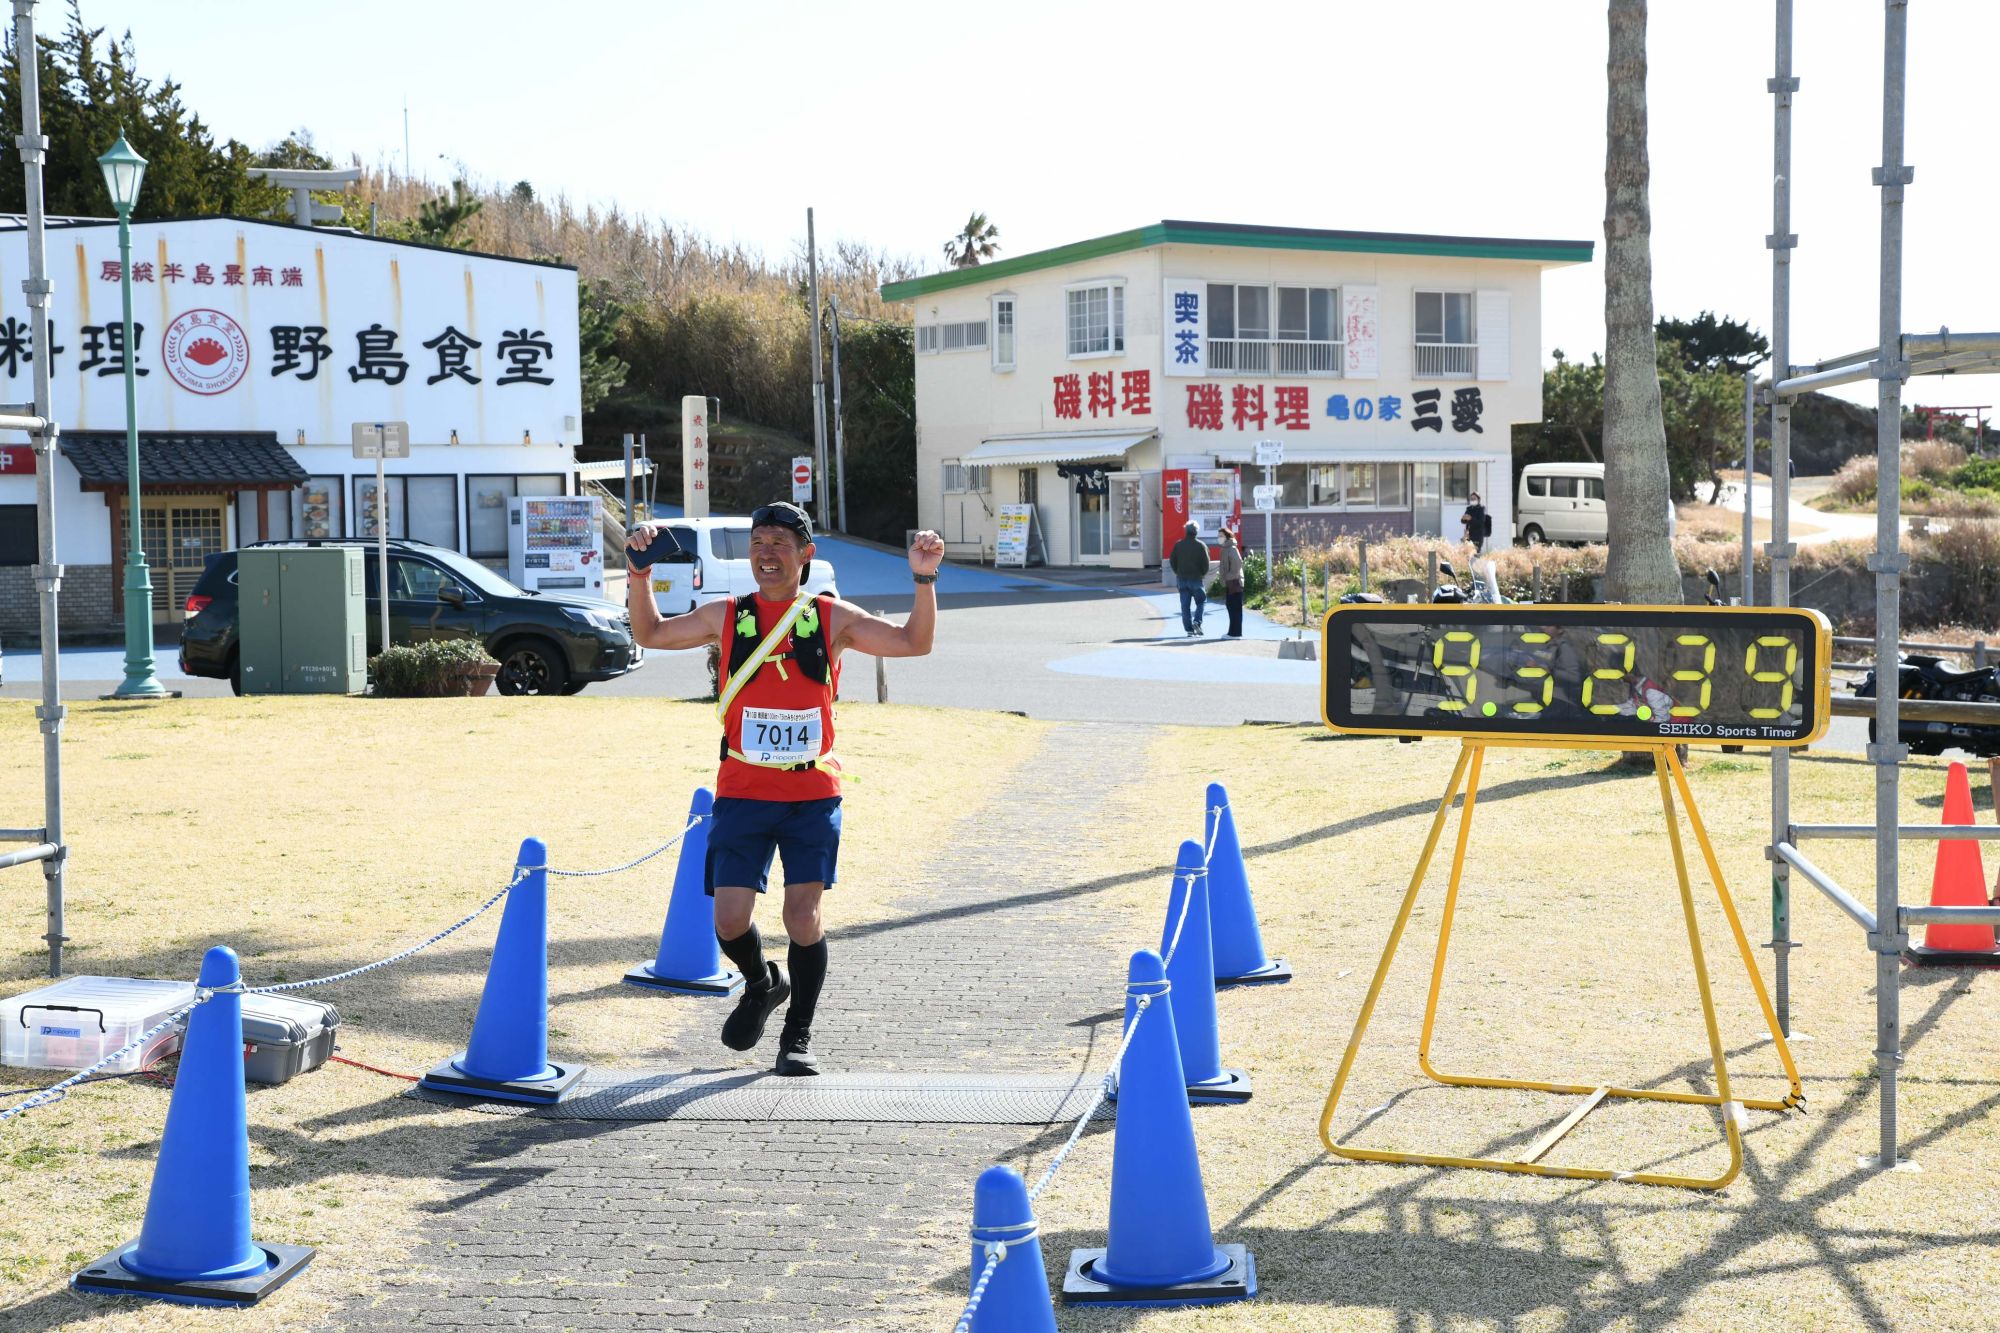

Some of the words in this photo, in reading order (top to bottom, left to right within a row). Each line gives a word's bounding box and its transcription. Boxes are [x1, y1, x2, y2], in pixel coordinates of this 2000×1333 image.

[101, 261, 304, 287] 房総半島最南端
[173, 313, 236, 335] 野島食堂
[1174, 291, 1200, 364] 喫茶
[270, 323, 555, 386] 野島食堂
[176, 366, 203, 388] NOJIMA
[205, 366, 239, 389] SHOKUDO
[1053, 369, 1151, 420] 磯料理
[1186, 383, 1311, 432] 磯料理
[1326, 394, 1402, 421] 亀の家
[1410, 386, 1485, 434] 三愛
[756, 724, 809, 745] 7014
[1659, 723, 1713, 736] SEIKO
[1716, 725, 1757, 738] Sports
[1761, 726, 1798, 738] Timer
